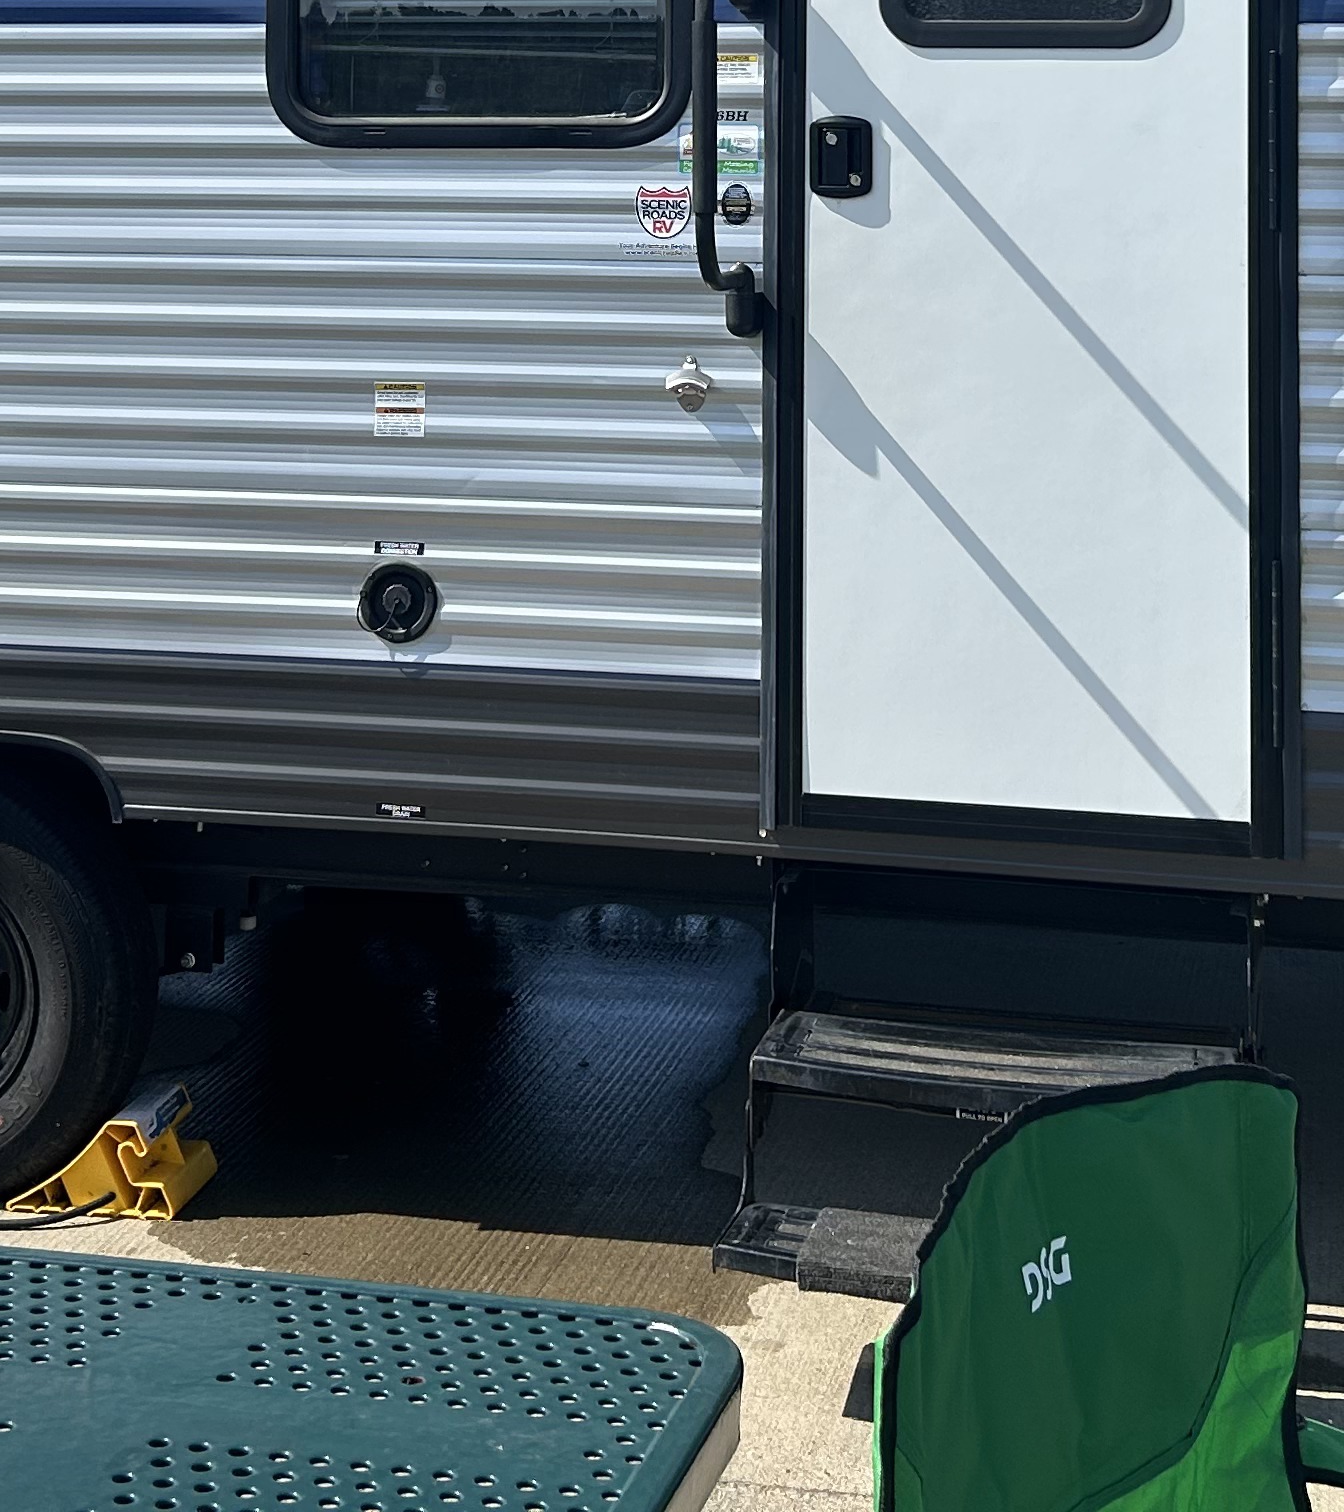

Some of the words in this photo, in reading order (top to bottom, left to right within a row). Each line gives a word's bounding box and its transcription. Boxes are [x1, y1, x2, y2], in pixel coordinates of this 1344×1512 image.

[640, 199, 688, 210] SCENIC
[642, 210, 686, 220] ROADS
[652, 220, 675, 234] RV
[1021, 1235, 1072, 1314] DSG
